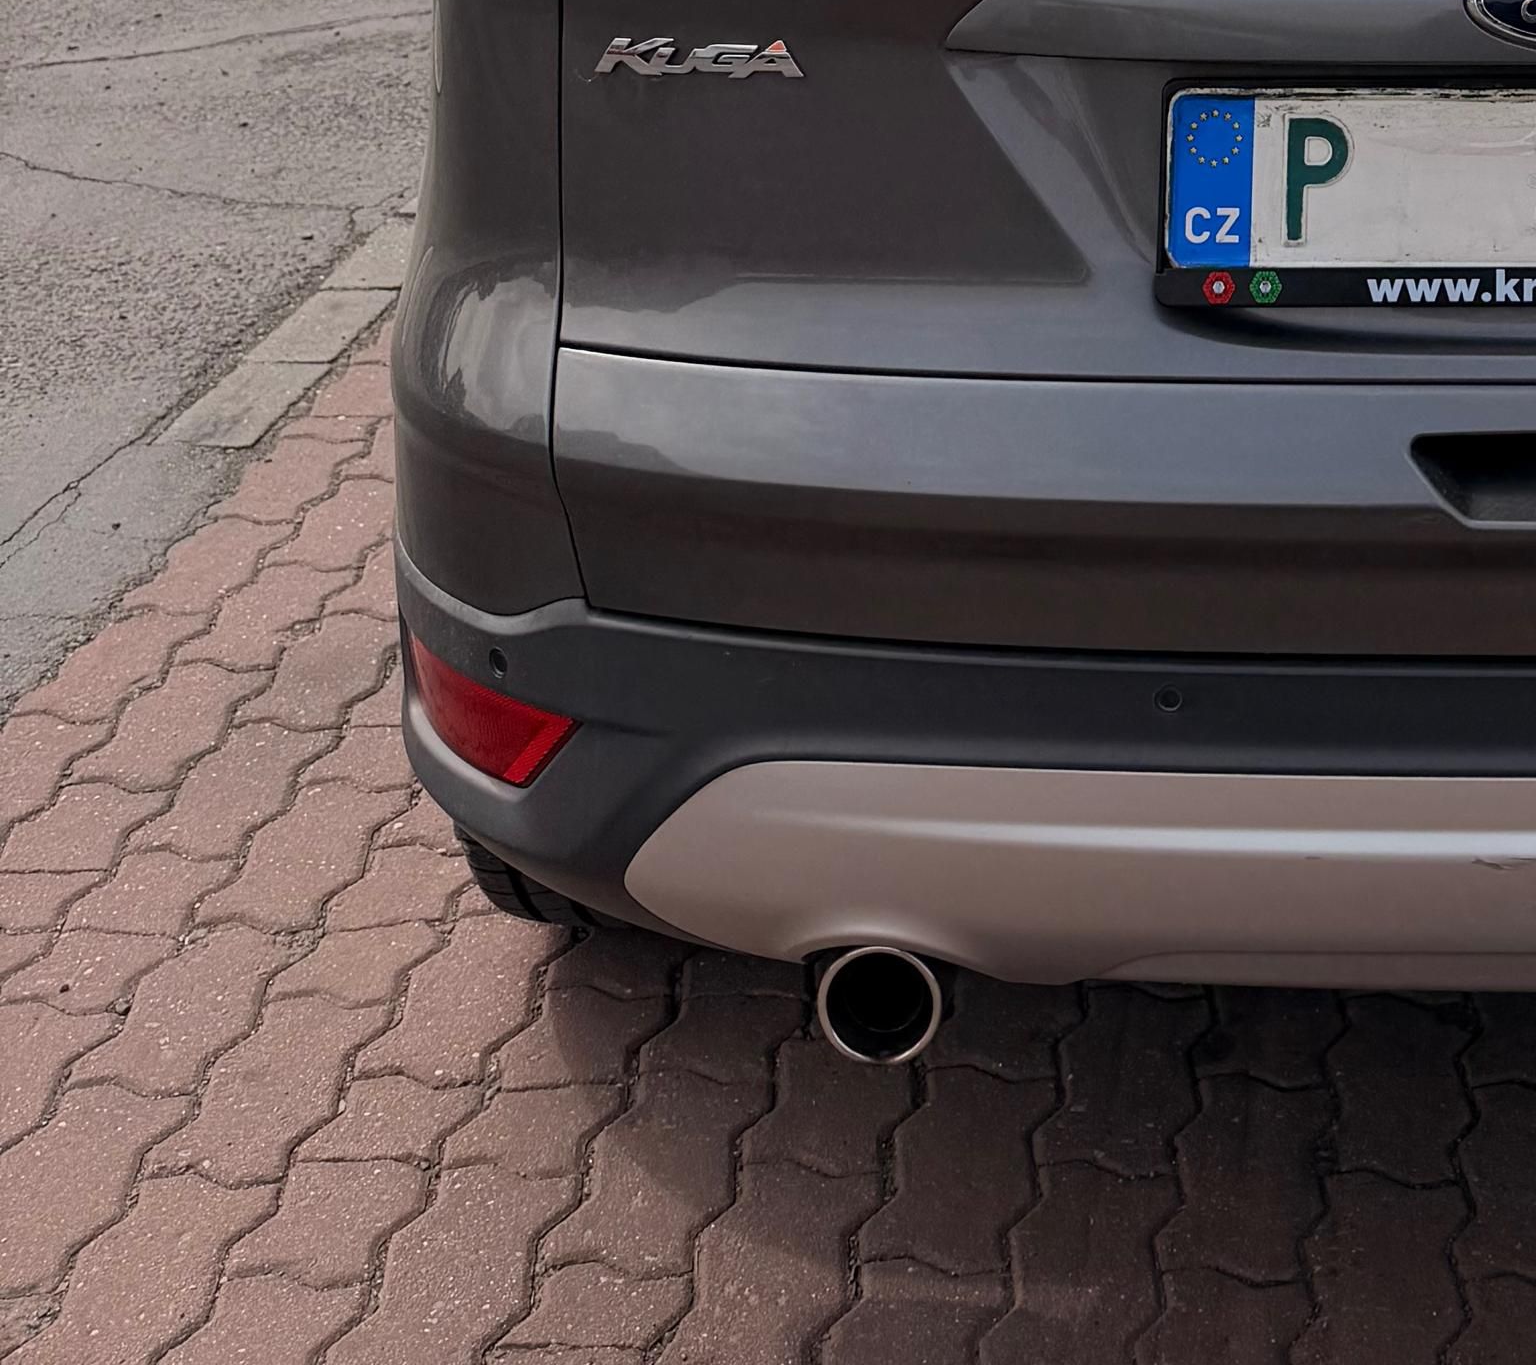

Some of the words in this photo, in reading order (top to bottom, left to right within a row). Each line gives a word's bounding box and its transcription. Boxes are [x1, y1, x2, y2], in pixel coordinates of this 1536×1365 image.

[594, 37, 805, 79] KUGA
[1285, 116, 1351, 243] P
[1184, 206, 1241, 245] CZ
